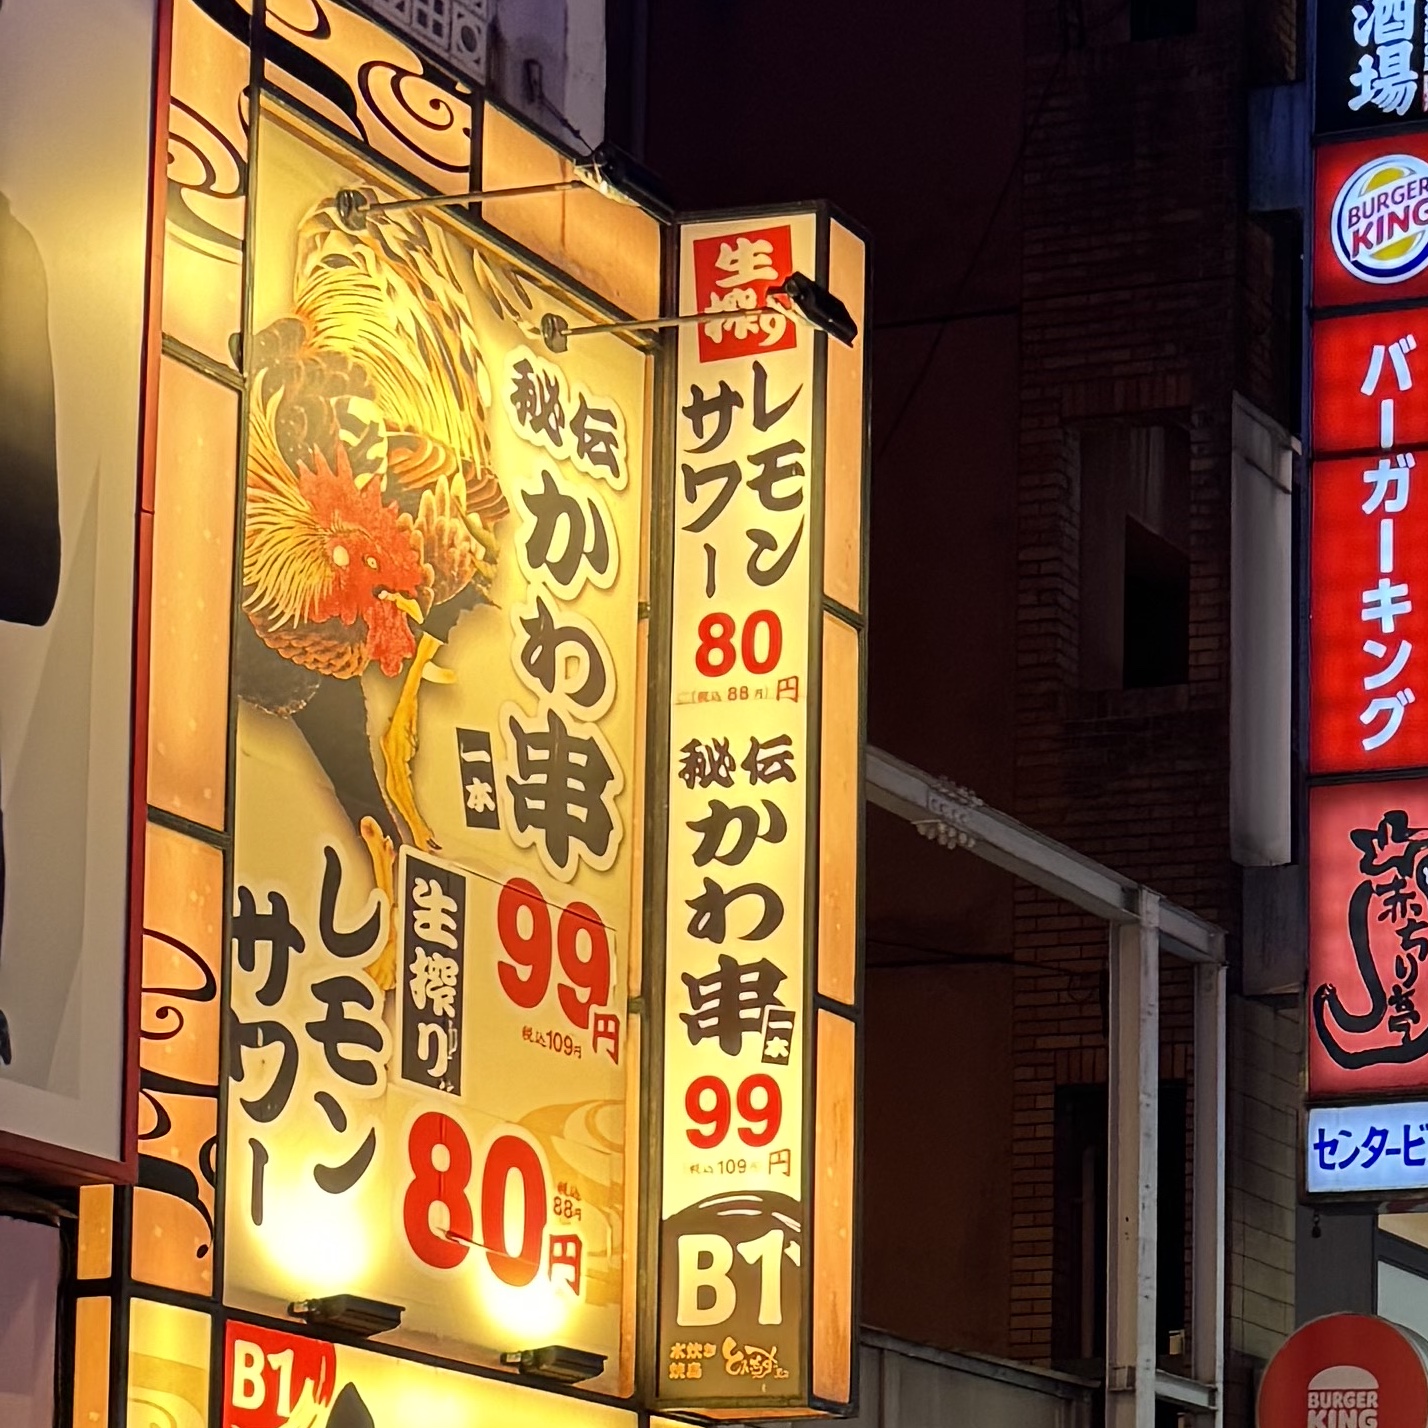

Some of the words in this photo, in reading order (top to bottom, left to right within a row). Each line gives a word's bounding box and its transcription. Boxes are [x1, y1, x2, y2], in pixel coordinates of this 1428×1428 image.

[509, 358, 622, 474] 秘伝
[681, 385, 743, 595] サワー
[747, 362, 806, 587] レモン
[1360, 333, 1418, 752] バーガーキング
[509, 471, 614, 866] かわ串
[694, 609, 783, 678] 80
[775, 676, 800, 703] 円
[678, 734, 797, 787] 秘伝
[408, 877, 463, 1088] 生搾り
[497, 877, 611, 1029] 99
[681, 800, 788, 1056] かわ串
[230, 885, 304, 1226] サワー
[309, 845, 386, 1194] レモン
[592, 1010, 621, 1066] 円
[685, 1072, 782, 1150] 99
[768, 1151, 792, 1177] 円
[403, 1112, 548, 1287] 80
[548, 1233, 583, 1296] 円
[676, 1230, 790, 1328] B1
[233, 1335, 296, 1418] B1
[1308, 1391, 1378, 1409] BURGER
